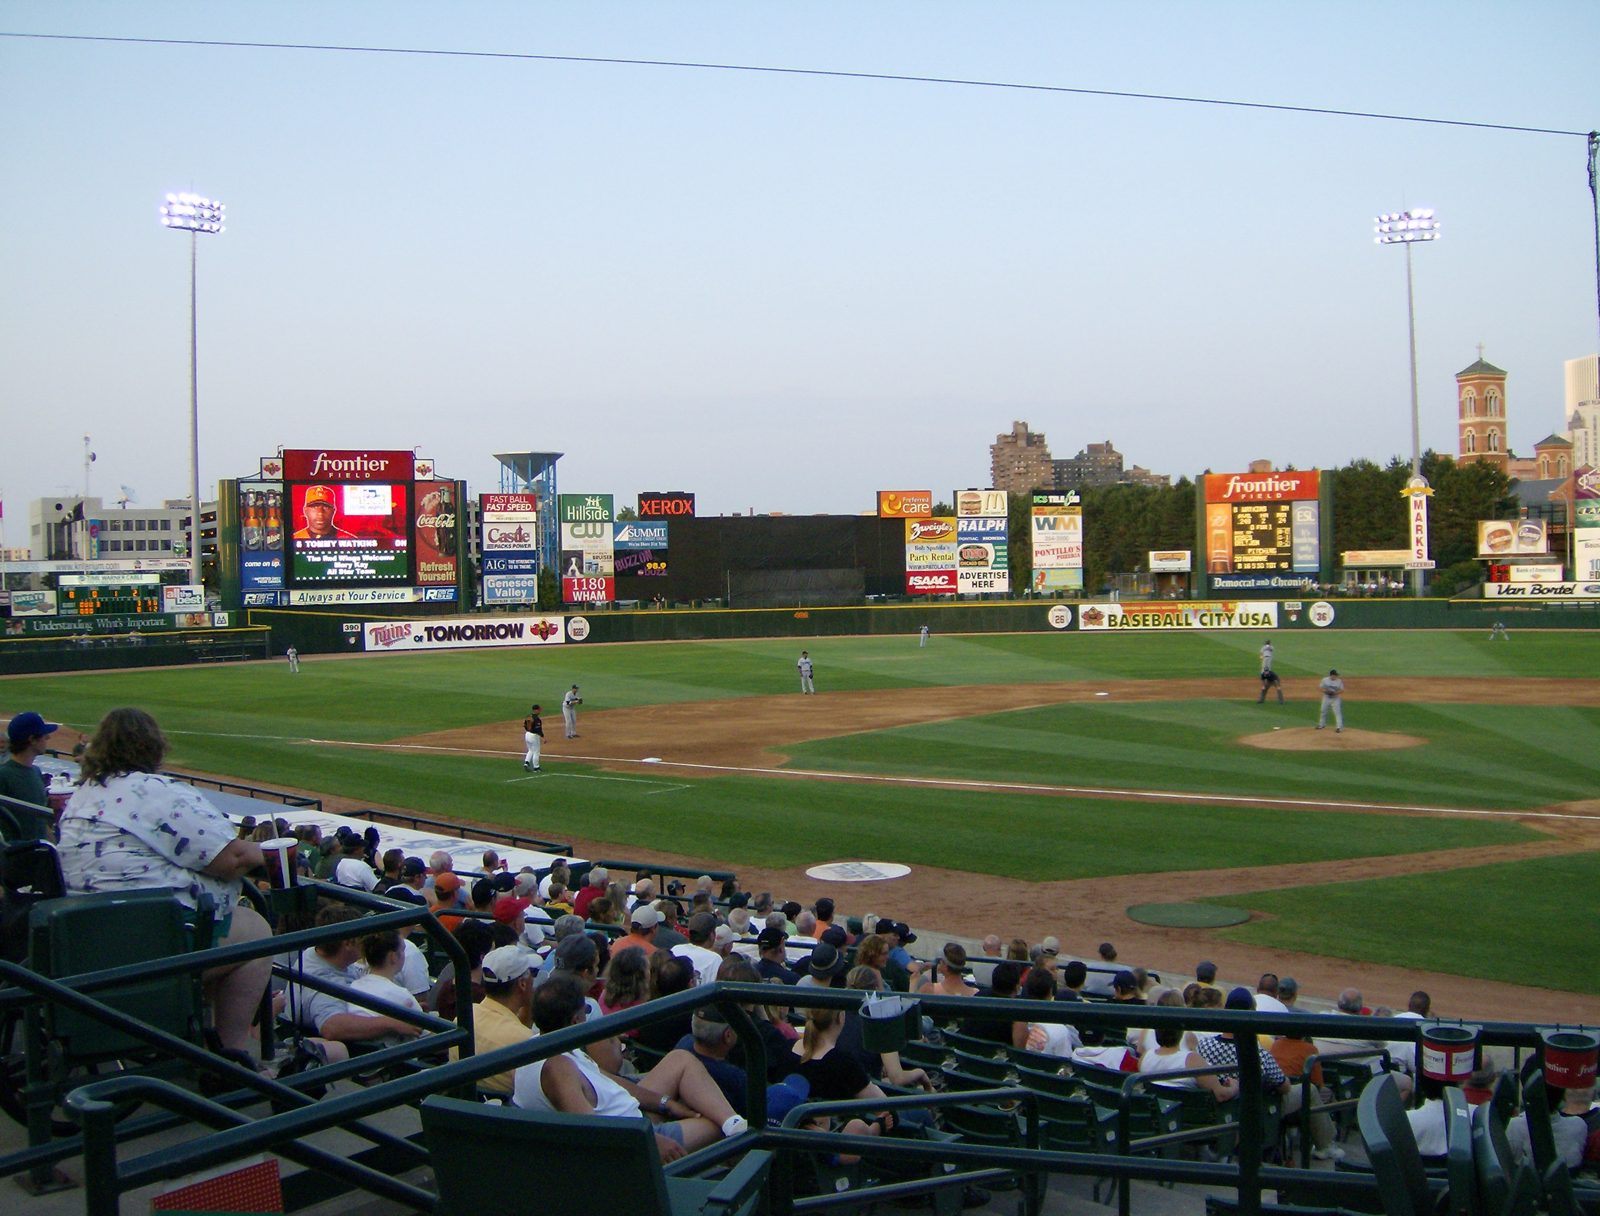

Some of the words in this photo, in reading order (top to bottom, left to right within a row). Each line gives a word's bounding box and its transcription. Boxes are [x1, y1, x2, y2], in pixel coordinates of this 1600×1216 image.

[310, 452, 389, 476] frontier
[1223, 475, 1300, 498] frontier
[489, 495, 508, 503] FAST
[567, 505, 610, 521] Hillside
[640, 499, 693, 515] XEROX
[902, 502, 930, 514] care
[1297, 510, 1316, 522] ESL
[957, 520, 1007, 532] RALPH
[487, 524, 531, 543] Castle
[628, 528, 667, 538] SUMMIT
[909, 553, 929, 563] Party
[931, 552, 955, 561] Rental
[420, 561, 454, 572] Refresh
[486, 559, 506, 570] AIG
[646, 562, 667, 570] 98.9
[418, 570, 456, 582] Yourself!
[908, 575, 949, 586] ISAAC
[959, 571, 1007, 580] ADVERTISE
[487, 579, 534, 588] Genesee
[571, 577, 606, 591] 1180
[971, 580, 995, 588] HERE
[1213, 577, 1255, 588] Democrat
[494, 588, 527, 598] Valley
[1497, 584, 1527, 595] Van
[1529, 583, 1577, 595] Bortel
[298, 592, 333, 604] Always
[335, 594, 345, 602] at
[348, 591, 370, 601] Your
[370, 590, 406, 601] Service
[572, 590, 606, 602] WHAM
[33, 620, 94, 632] Understanding
[1107, 613, 1193, 628] BASEBALL
[1198, 612, 1235, 627] CITY
[1238, 612, 1273, 626] USA
[424, 622, 525, 643] TOMORROW
